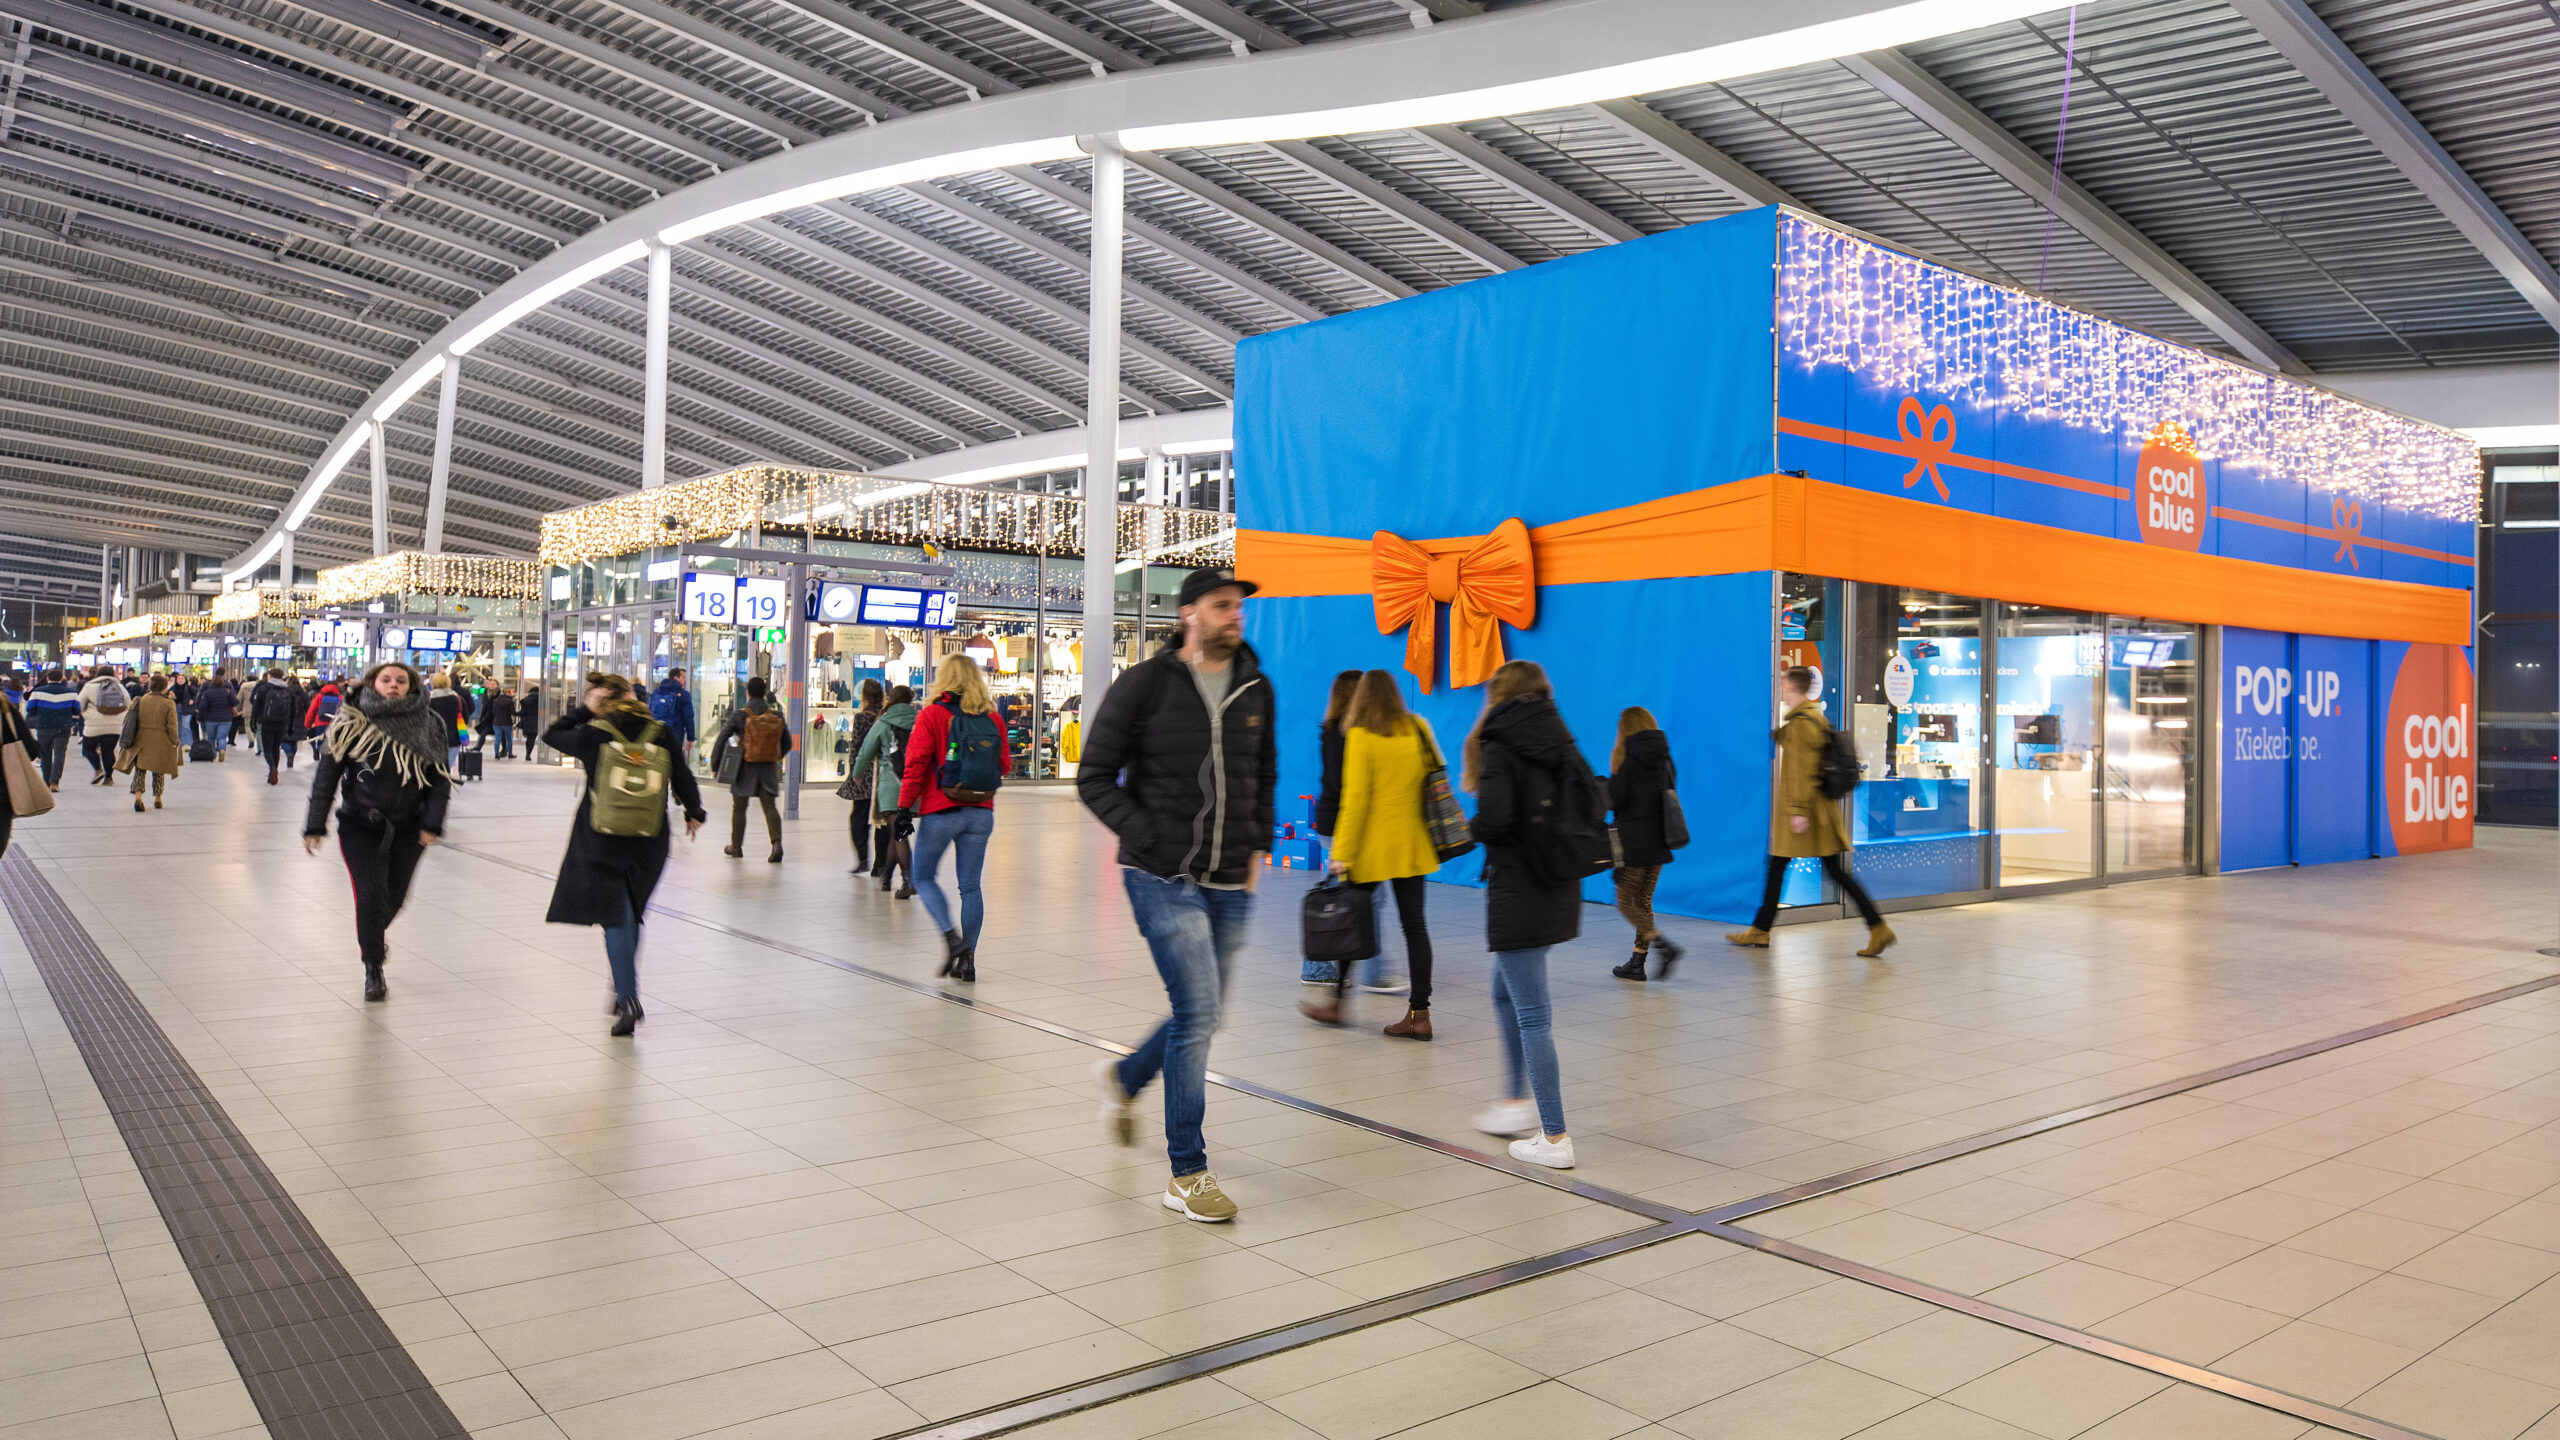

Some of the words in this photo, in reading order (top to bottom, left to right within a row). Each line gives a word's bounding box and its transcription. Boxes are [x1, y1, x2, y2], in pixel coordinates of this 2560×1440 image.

[2149, 466, 2195, 499] cool
[2149, 493, 2195, 533] blue
[695, 592, 725, 617] 18
[746, 596, 777, 620] 19
[2235, 665, 2341, 717] POP-UP.
[2404, 703, 2468, 759] cool
[2404, 762, 2468, 823] blue
